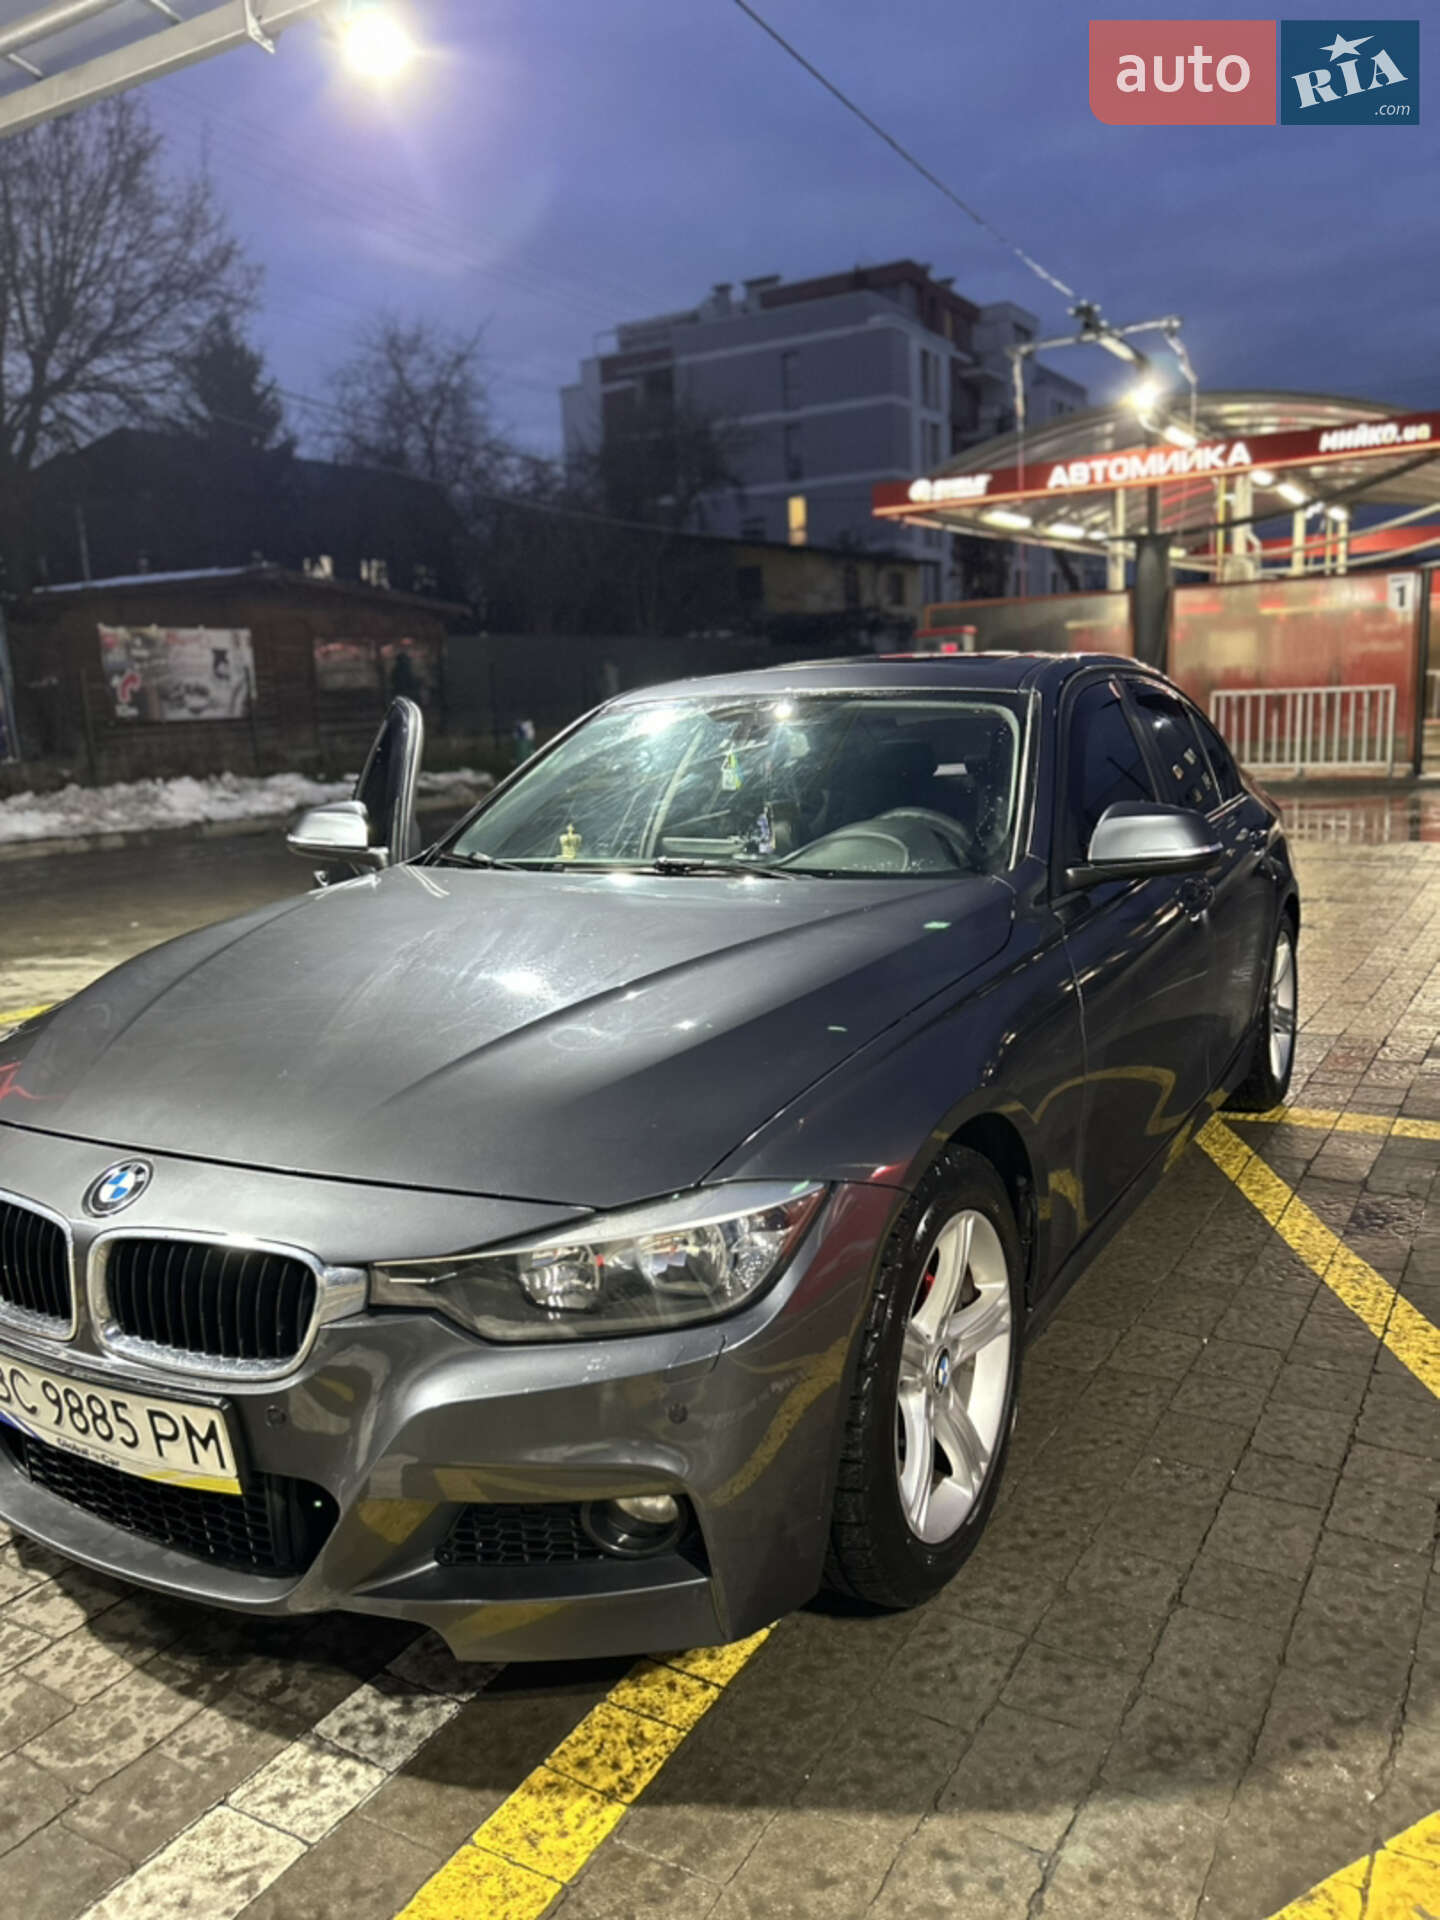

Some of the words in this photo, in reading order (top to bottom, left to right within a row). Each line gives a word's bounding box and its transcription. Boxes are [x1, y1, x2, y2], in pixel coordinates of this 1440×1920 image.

[1396, 585, 1406, 608] 1
[42, 1380, 139, 1449] 9885
[147, 1408, 227, 1470] PM
